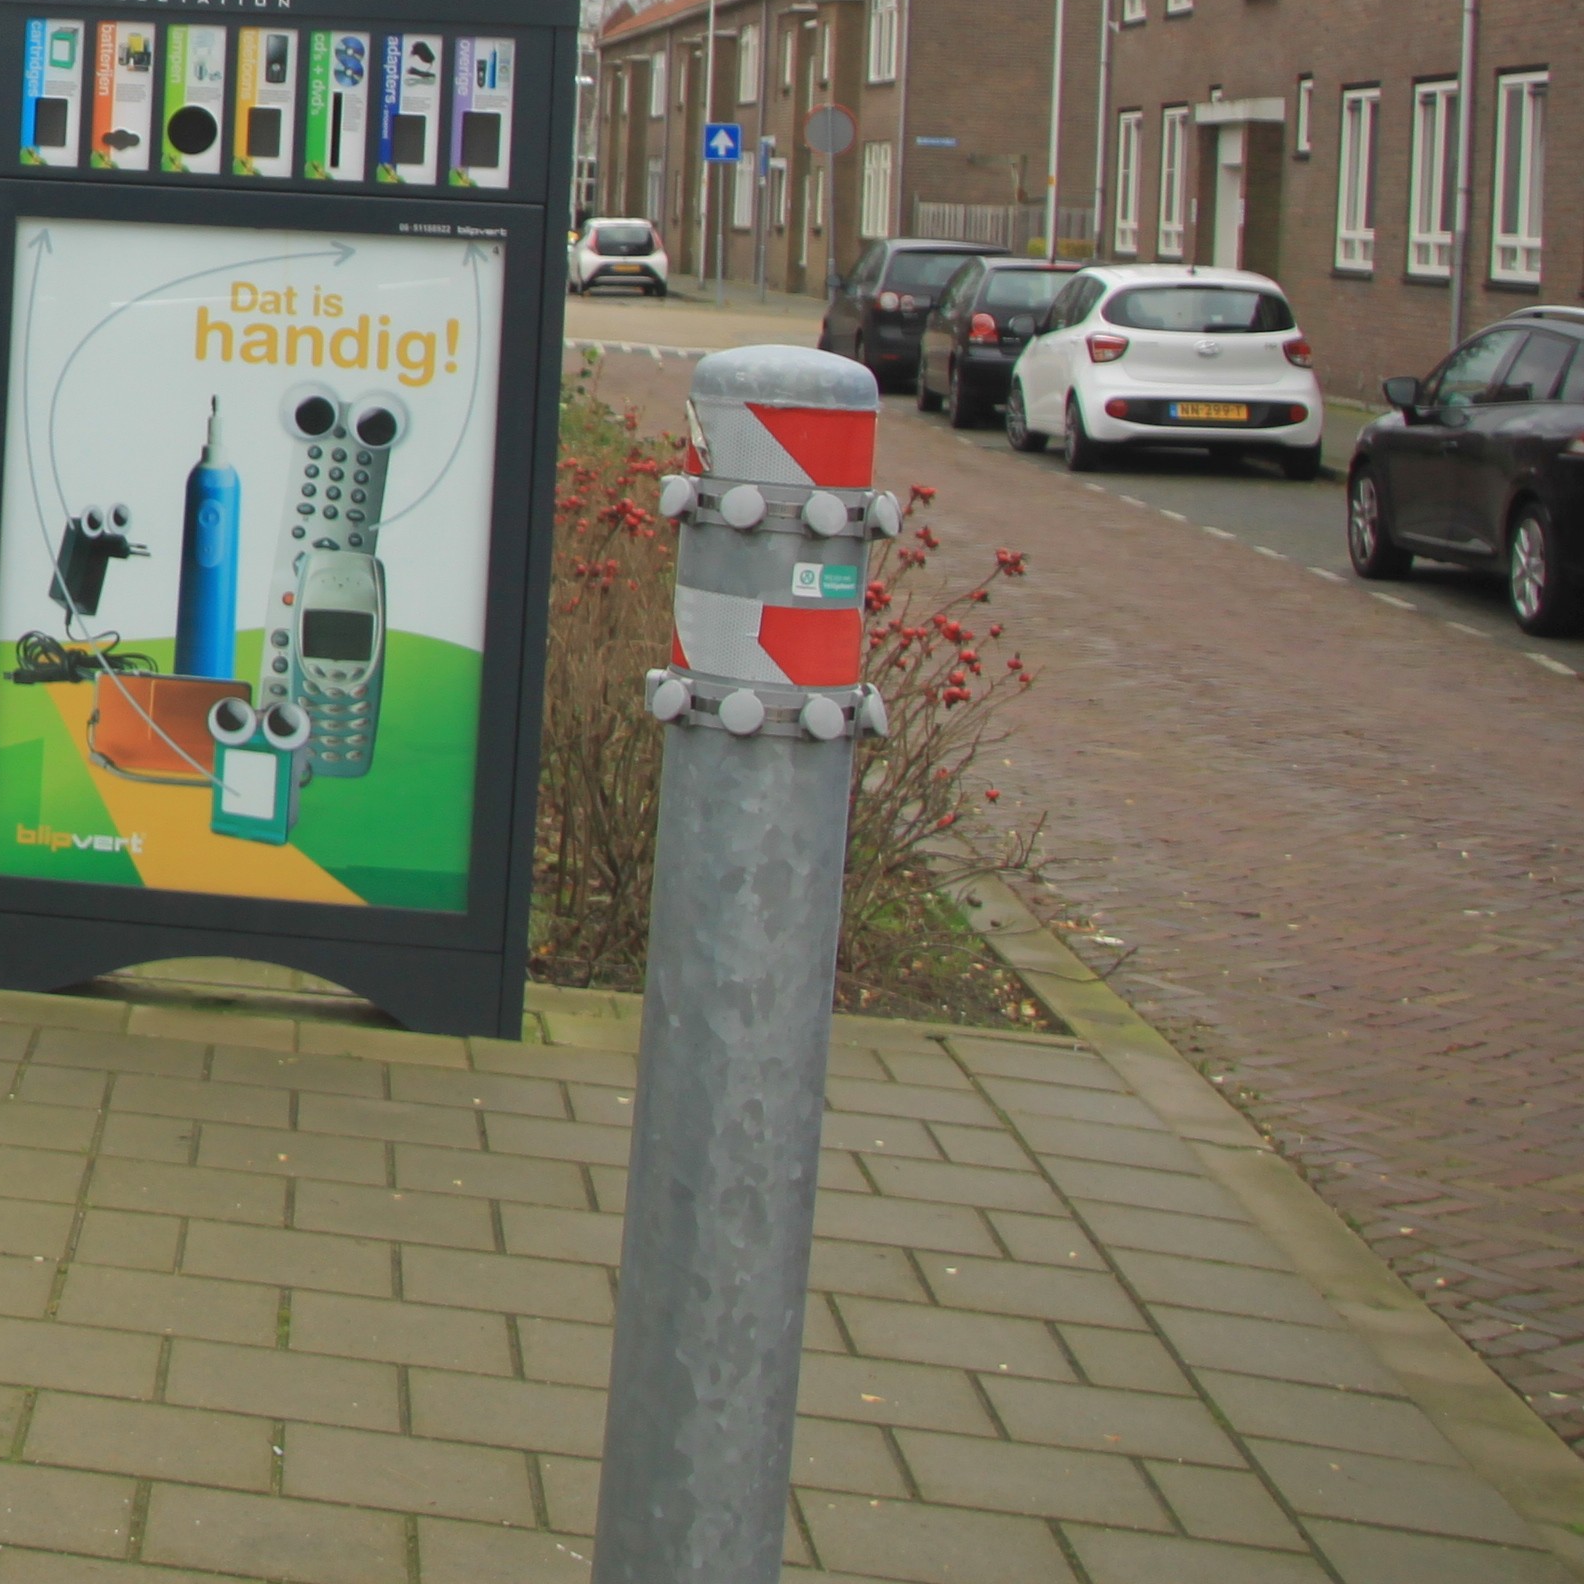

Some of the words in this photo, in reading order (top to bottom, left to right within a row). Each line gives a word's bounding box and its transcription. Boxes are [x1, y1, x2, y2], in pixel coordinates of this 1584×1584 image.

[24, 20, 44, 97] cartridges
[96, 23, 116, 96] batterijen
[169, 27, 187, 83] lampen
[454, 39, 472, 97] overige
[230, 281, 297, 315] Dat
[312, 285, 344, 317] is
[195, 305, 460, 388] handig!
[16, 823, 144, 854] blipvert
